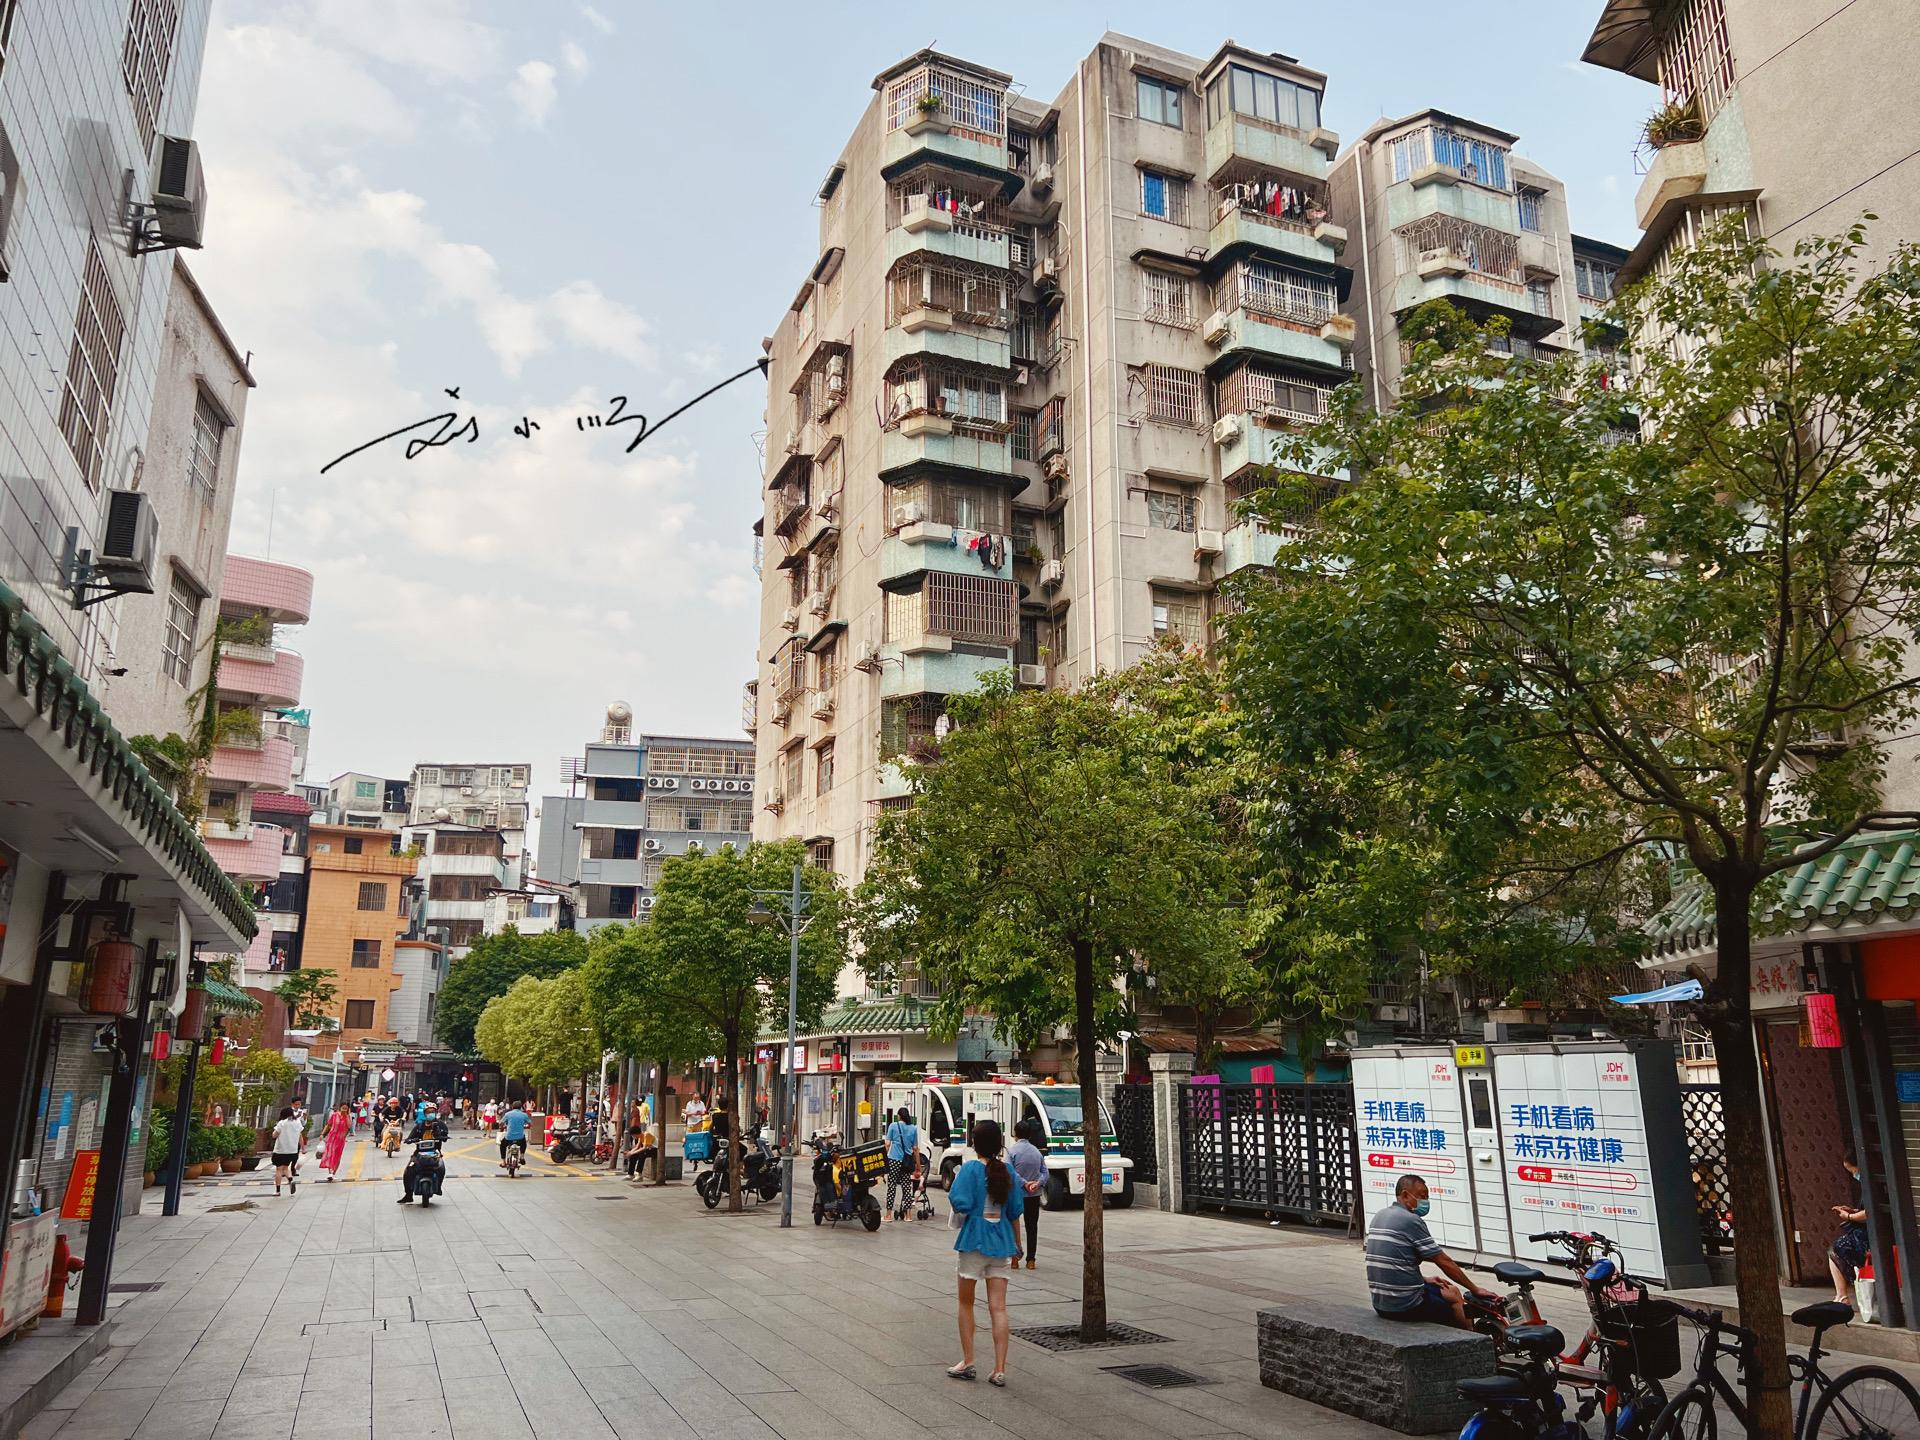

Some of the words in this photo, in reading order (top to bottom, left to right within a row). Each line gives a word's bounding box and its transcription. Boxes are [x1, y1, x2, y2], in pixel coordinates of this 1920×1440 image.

[1435, 1064, 1447, 1073] JDH
[1601, 1074, 1629, 1082] 京东健康
[1606, 1062, 1623, 1073] JDH
[1363, 1100, 1425, 1123] 手机看病
[1510, 1104, 1595, 1131] 手机看病
[1366, 1125, 1446, 1150] 来京东健康
[1514, 1133, 1625, 1163] 来京东健康
[75, 1155, 100, 1217] 禁止停放单车
